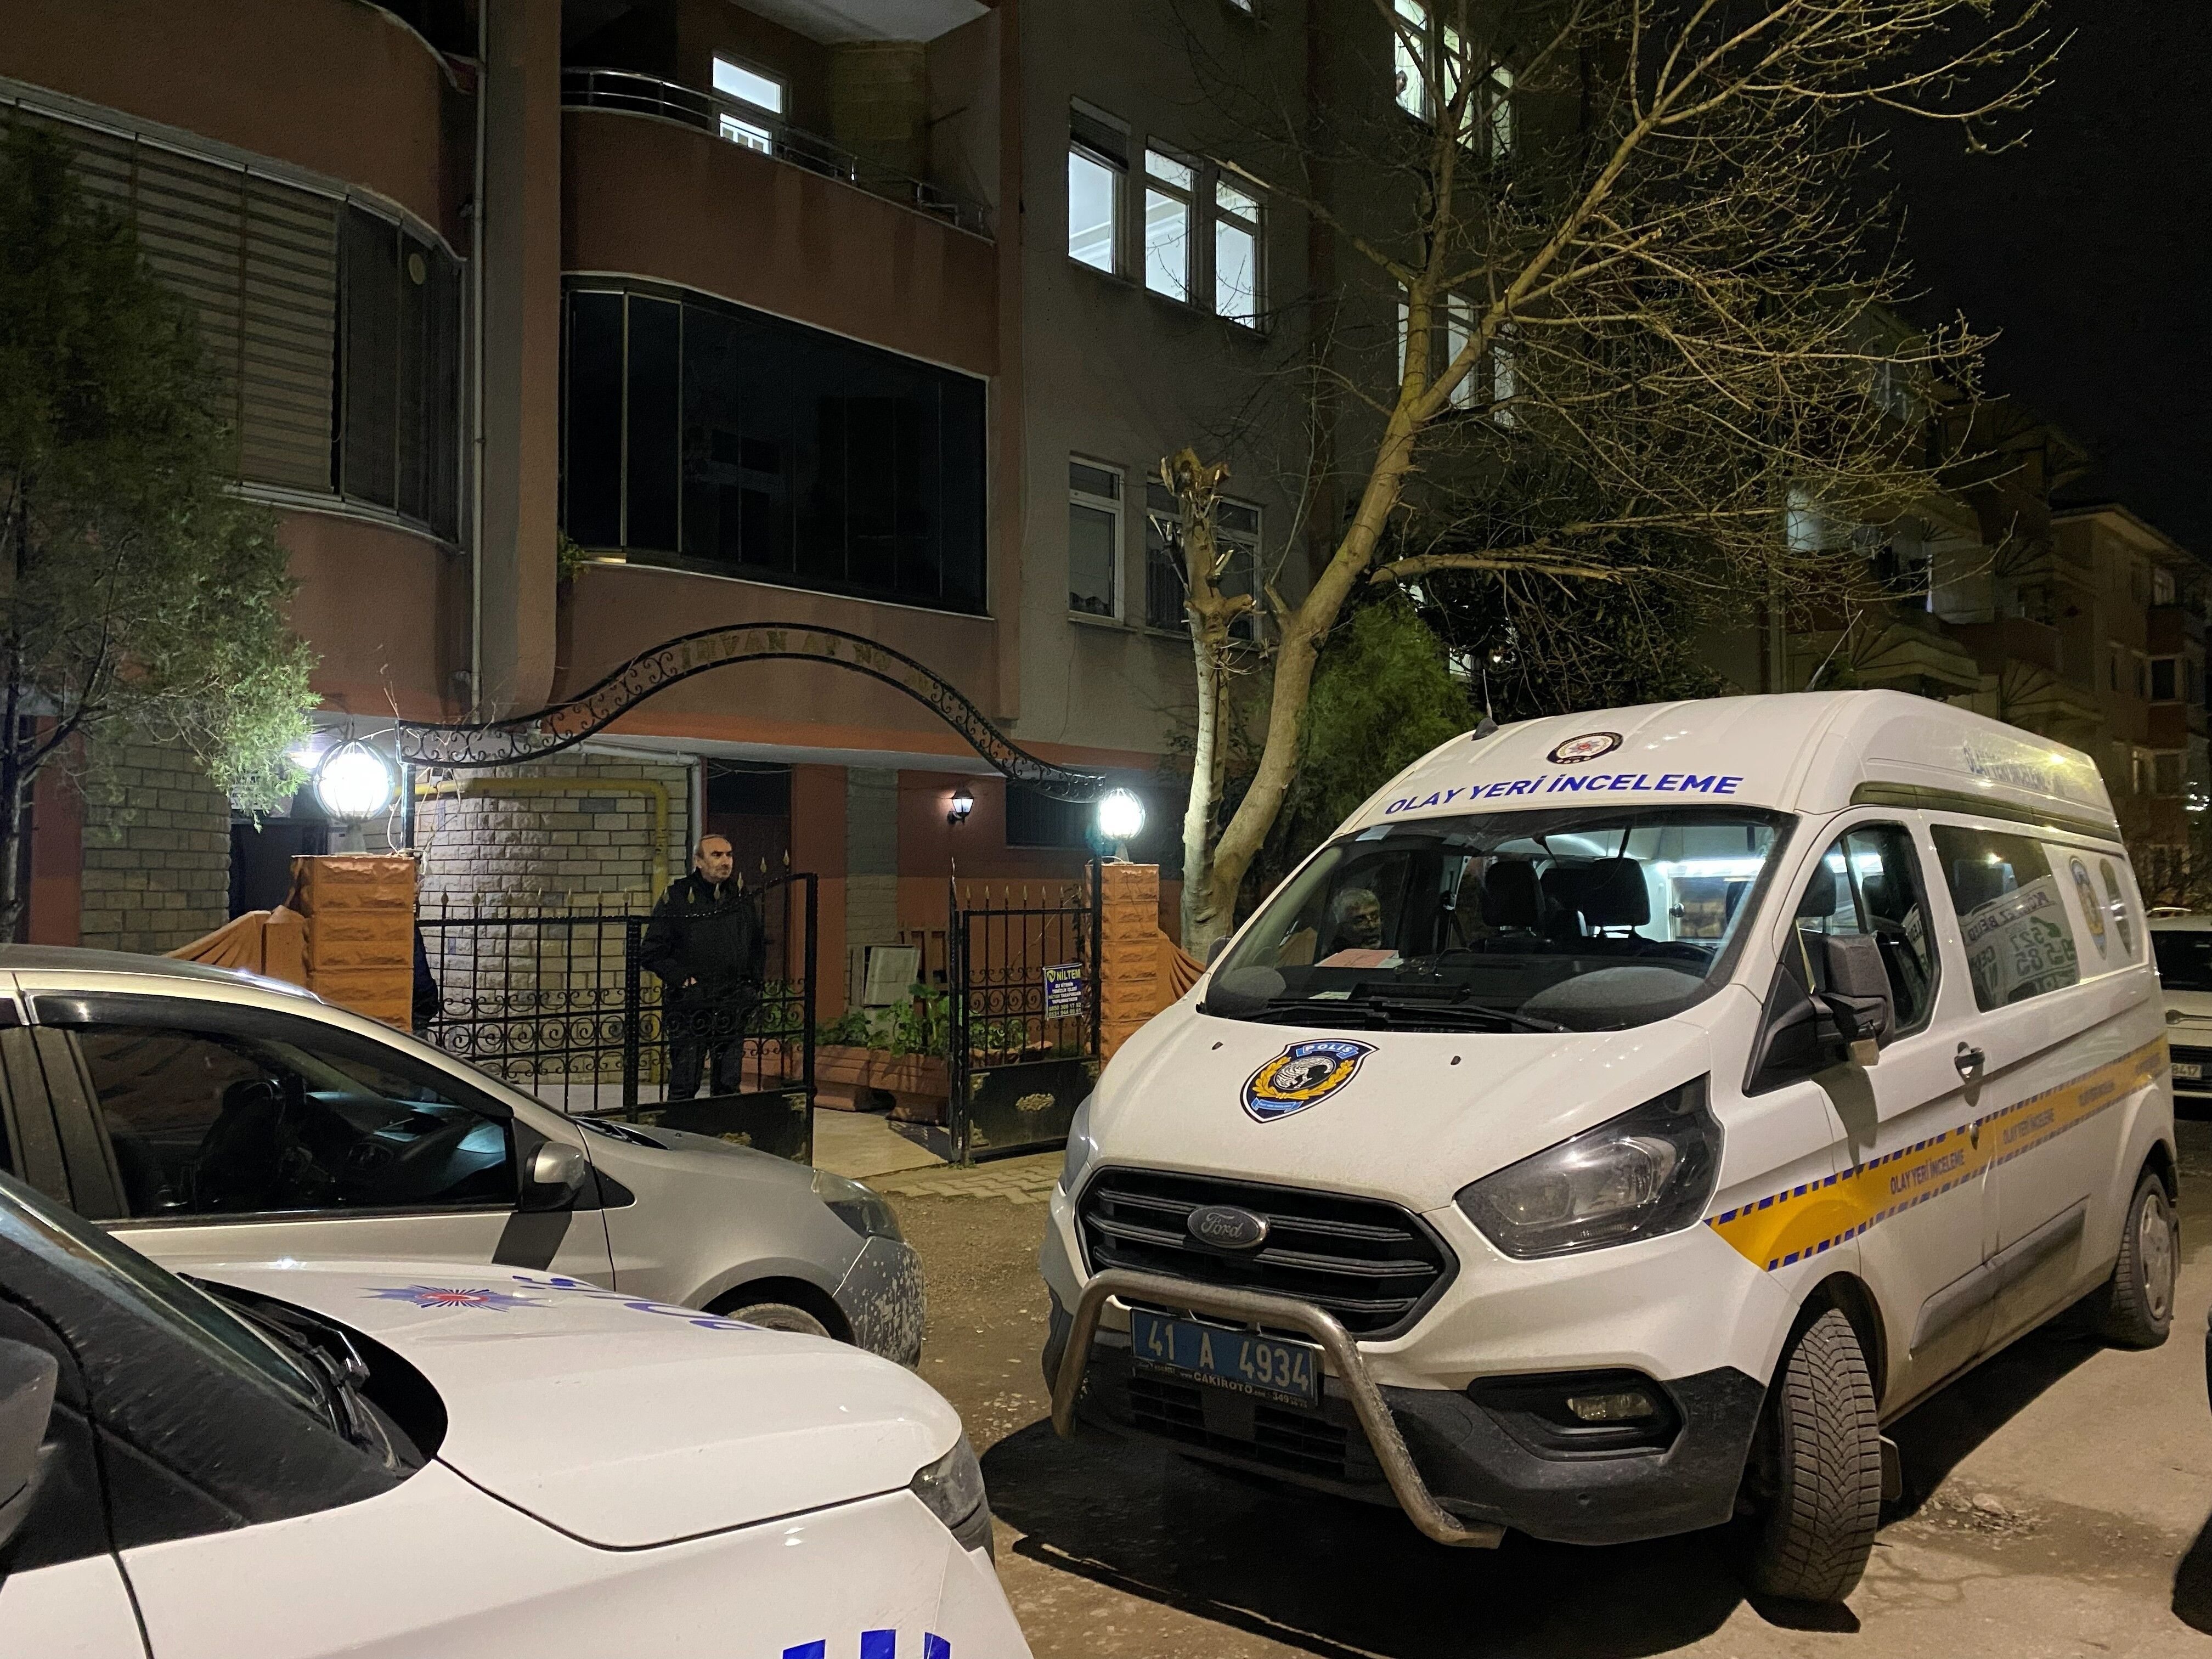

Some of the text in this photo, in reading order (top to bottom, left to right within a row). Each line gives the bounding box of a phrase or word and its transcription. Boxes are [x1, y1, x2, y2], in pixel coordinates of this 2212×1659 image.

[1385, 774, 1745, 815] OLAY YERİ İNCELEME
[1305, 1043, 1353, 1053] POLİS
[1890, 1171, 1911, 1195] OLAY
[1912, 1159, 1929, 1184] YERİ
[1200, 1212, 1244, 1238] Ford
[1148, 1321, 1309, 1391] 41 A 4934
